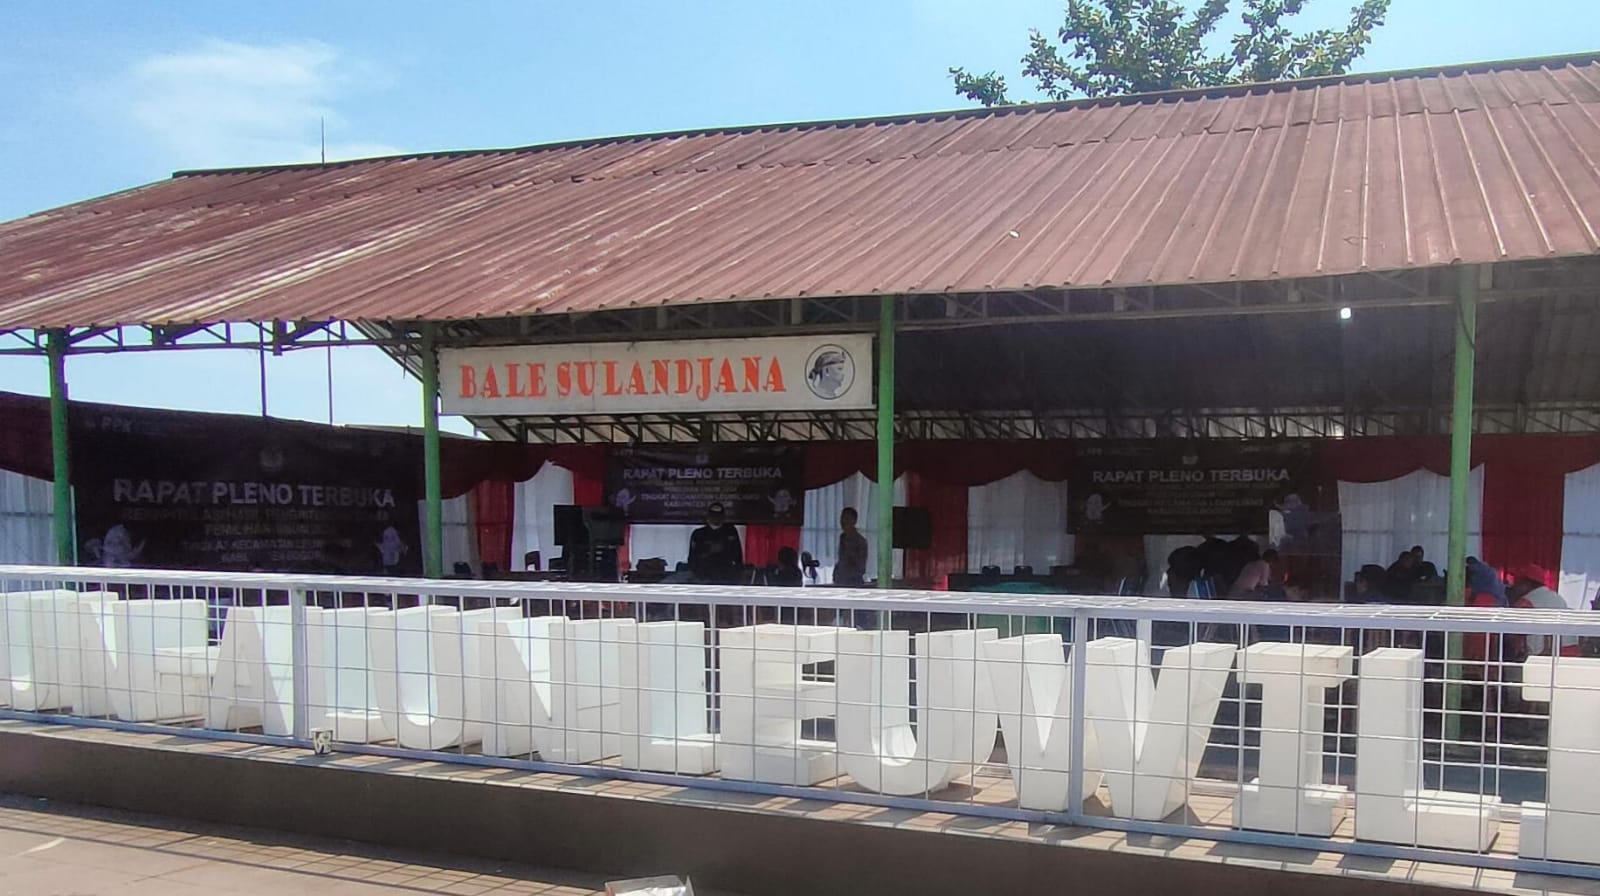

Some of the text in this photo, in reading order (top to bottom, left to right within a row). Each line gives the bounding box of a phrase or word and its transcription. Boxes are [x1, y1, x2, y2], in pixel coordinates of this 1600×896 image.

[459, 354, 787, 401] BALE SULANDJANA
[623, 467, 782, 479] RAPAT PLENO TERBUKA
[1092, 468, 1291, 482] RAPAT PLENO TERBUKA
[113, 478, 396, 508] RAPAT PLENO TERBUKA
